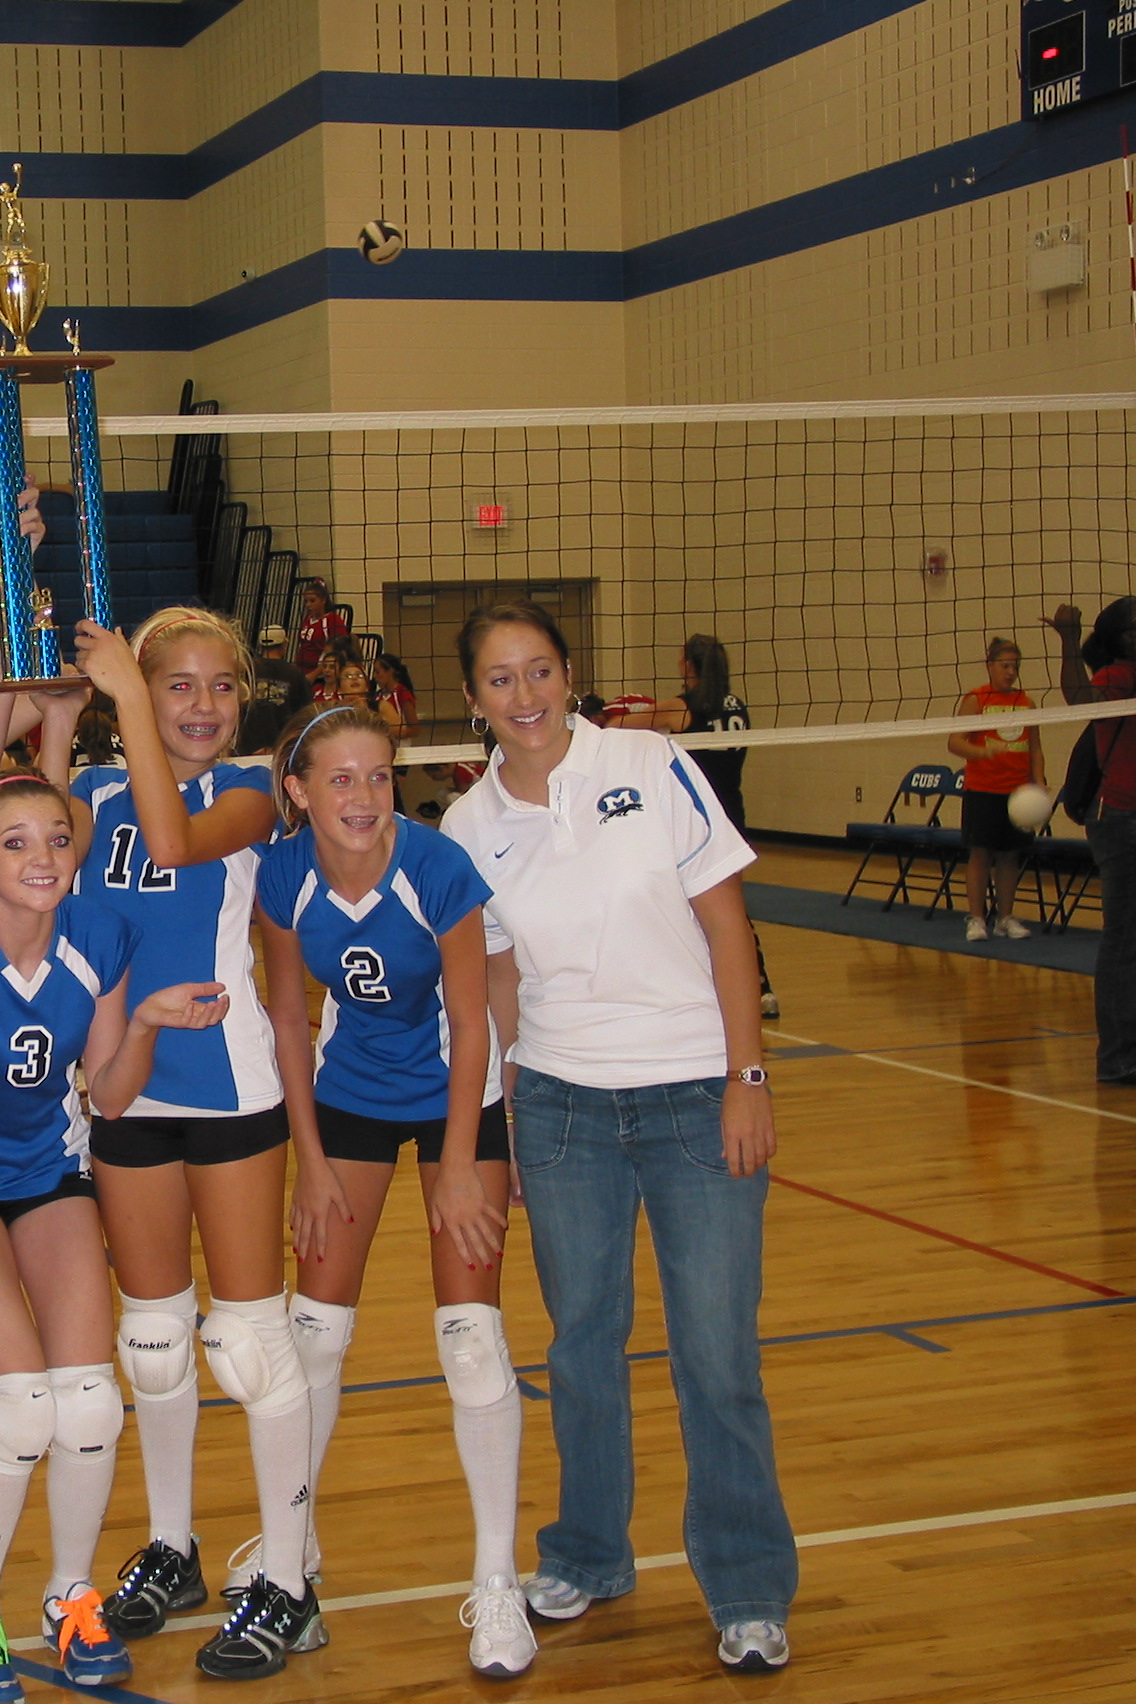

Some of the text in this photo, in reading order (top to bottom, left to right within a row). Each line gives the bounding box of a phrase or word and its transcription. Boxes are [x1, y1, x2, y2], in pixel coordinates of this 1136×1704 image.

[1033, 75, 1082, 115] HOME
[478, 505, 503, 526] EXIT
[910, 772, 942, 789] CUBS
[340, 946, 392, 1003] 2
[6, 1025, 54, 1088] 3
